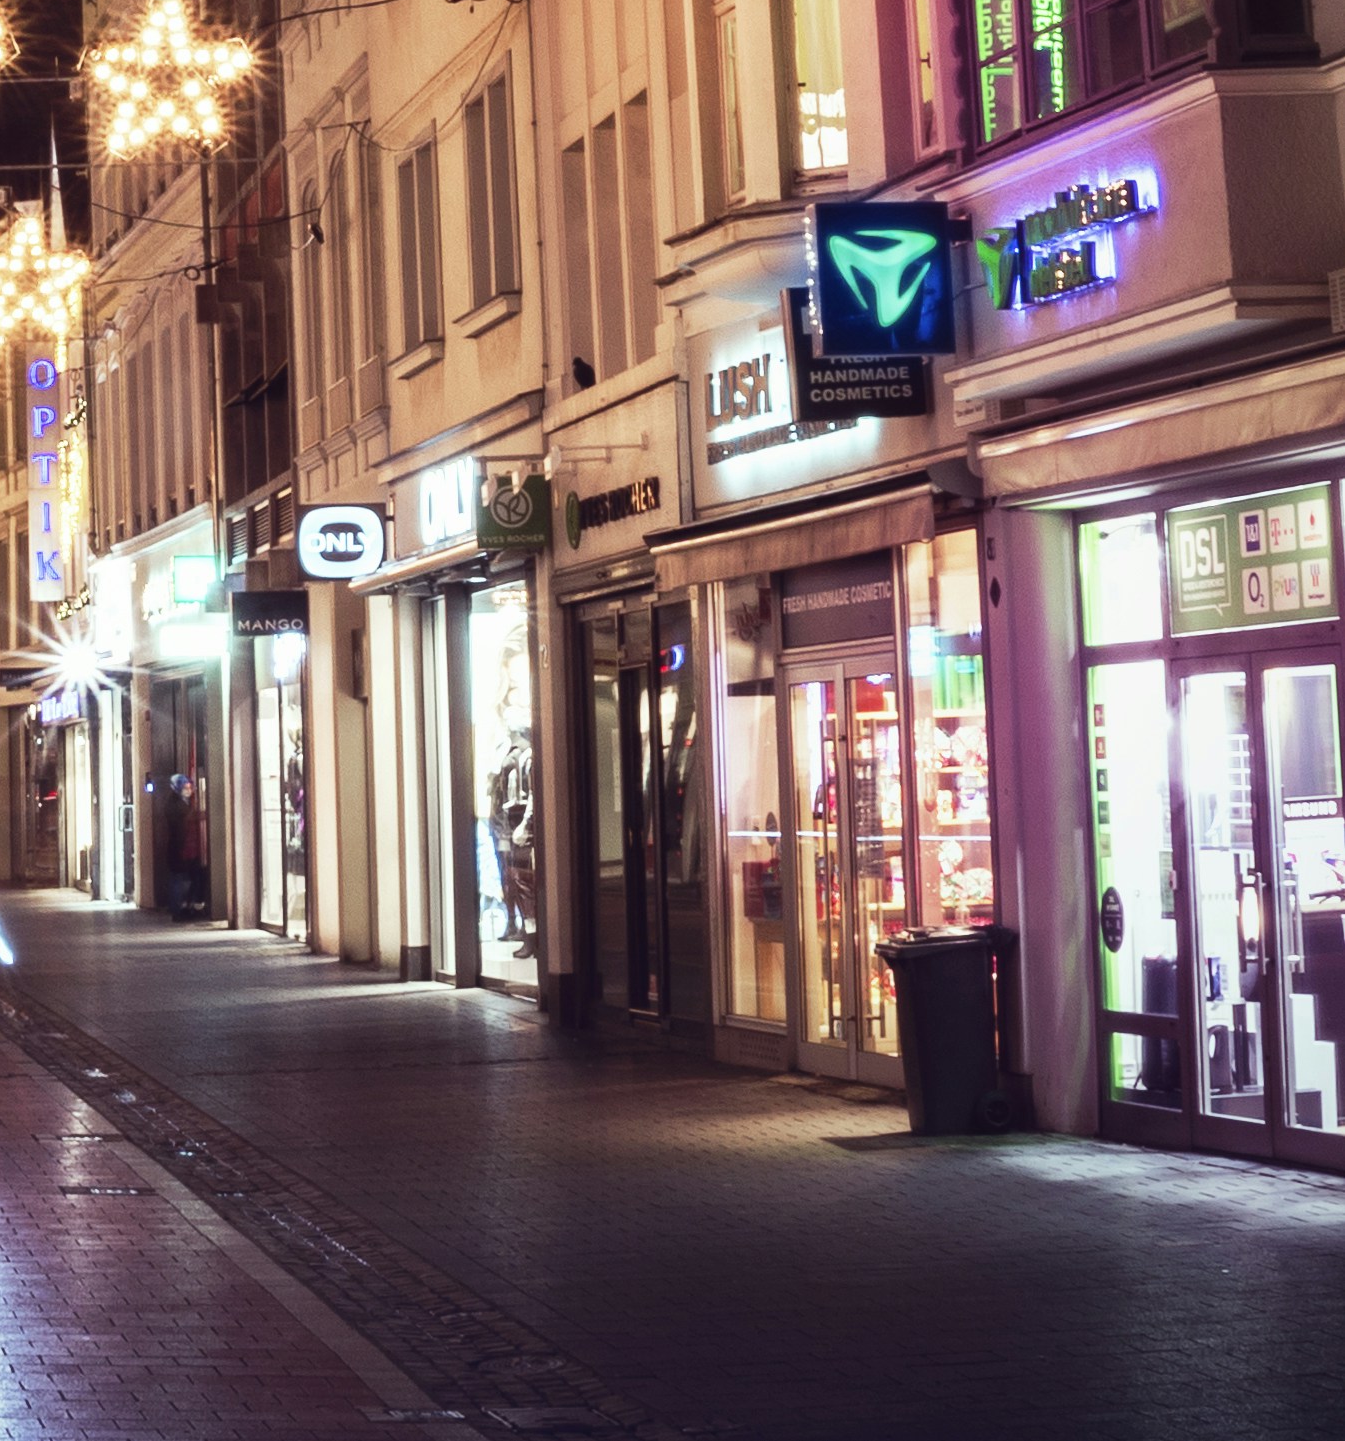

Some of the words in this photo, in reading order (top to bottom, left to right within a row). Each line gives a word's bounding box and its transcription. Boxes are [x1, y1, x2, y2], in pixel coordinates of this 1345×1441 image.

[810, 366, 911, 383] HANDMADE
[705, 354, 772, 432] LUSH
[810, 384, 913, 402] COSMETICS
[28, 358, 61, 581] OPTIK
[419, 456, 475, 546] ONLY
[307, 531, 376, 554] ONLY
[481, 535, 504, 544] YVES
[507, 533, 545, 543] ROCHER
[1179, 525, 1225, 579] DSL
[782, 597, 806, 614] FRESH
[808, 586, 849, 610] HANDMADE
[850, 580, 892, 604] COSMETIC
[237, 618, 304, 631] MANGO
